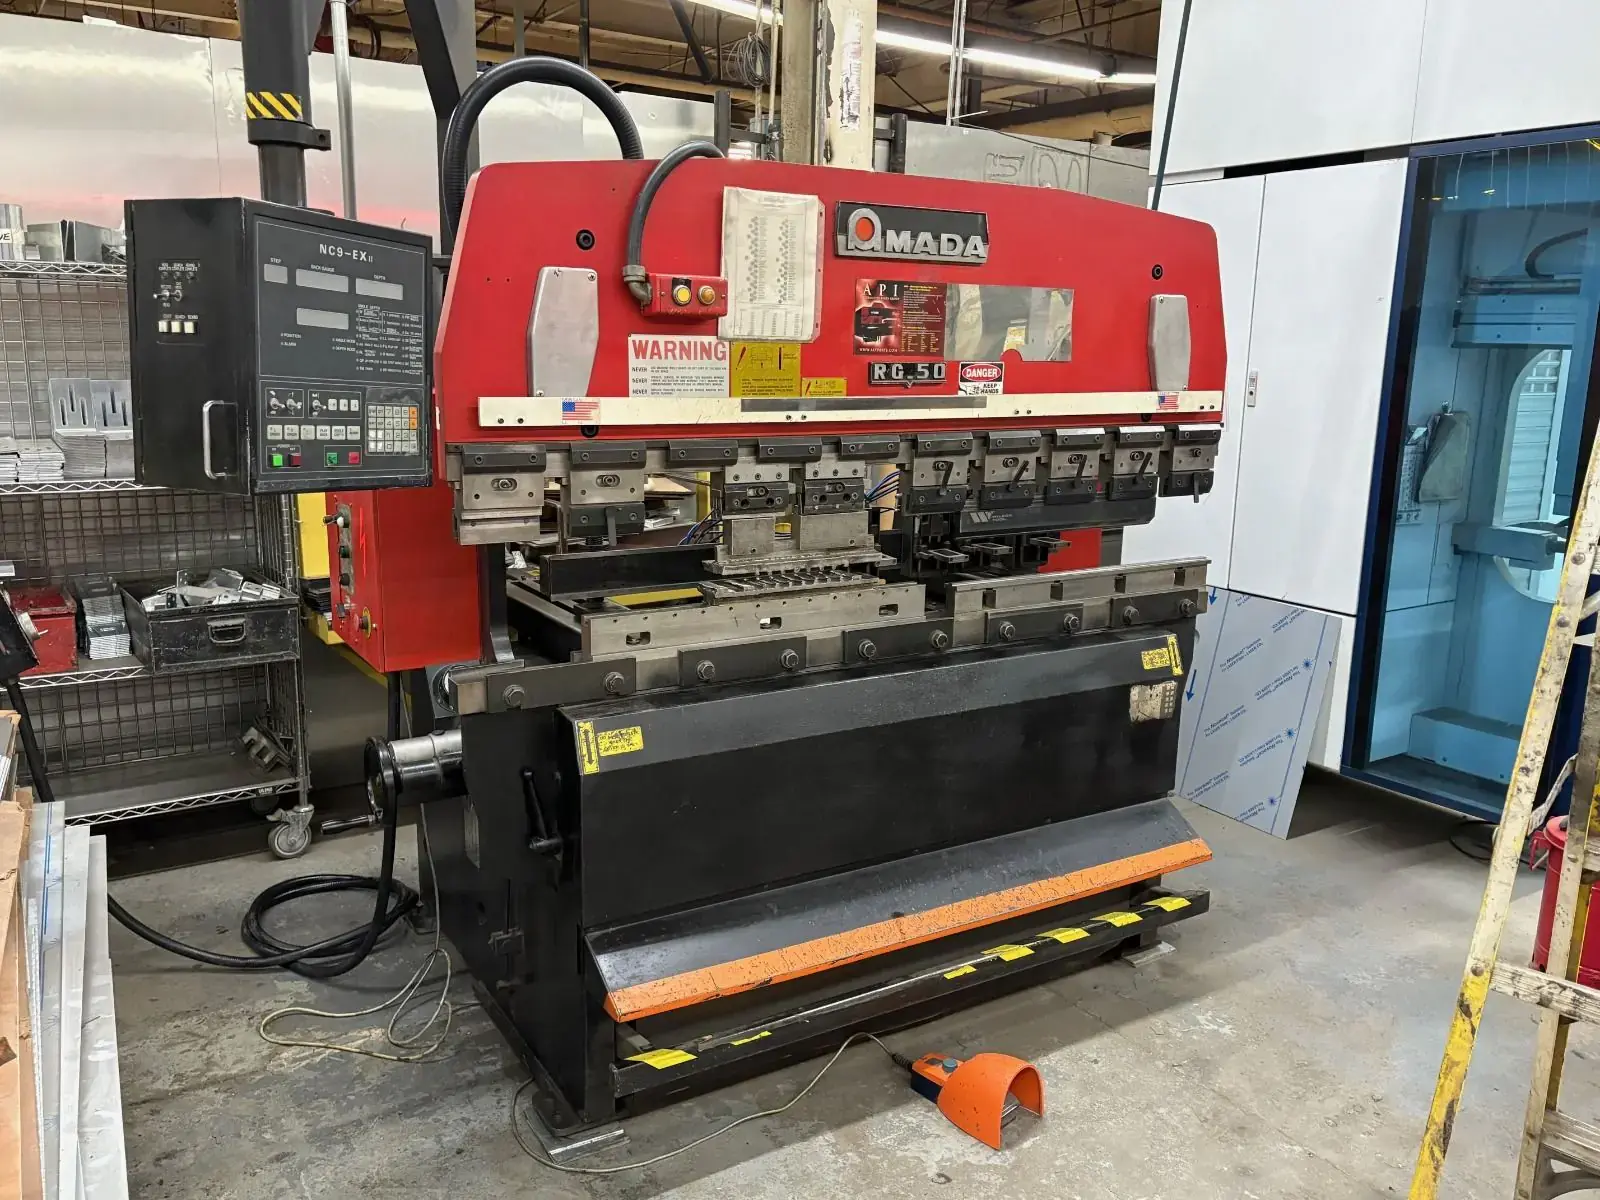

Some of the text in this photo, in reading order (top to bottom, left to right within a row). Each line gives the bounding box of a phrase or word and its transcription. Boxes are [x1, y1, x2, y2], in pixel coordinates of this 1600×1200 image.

[847, 207, 987, 258] AMADA
[631, 338, 728, 361] WARNING
[966, 368, 998, 378] DANGER
